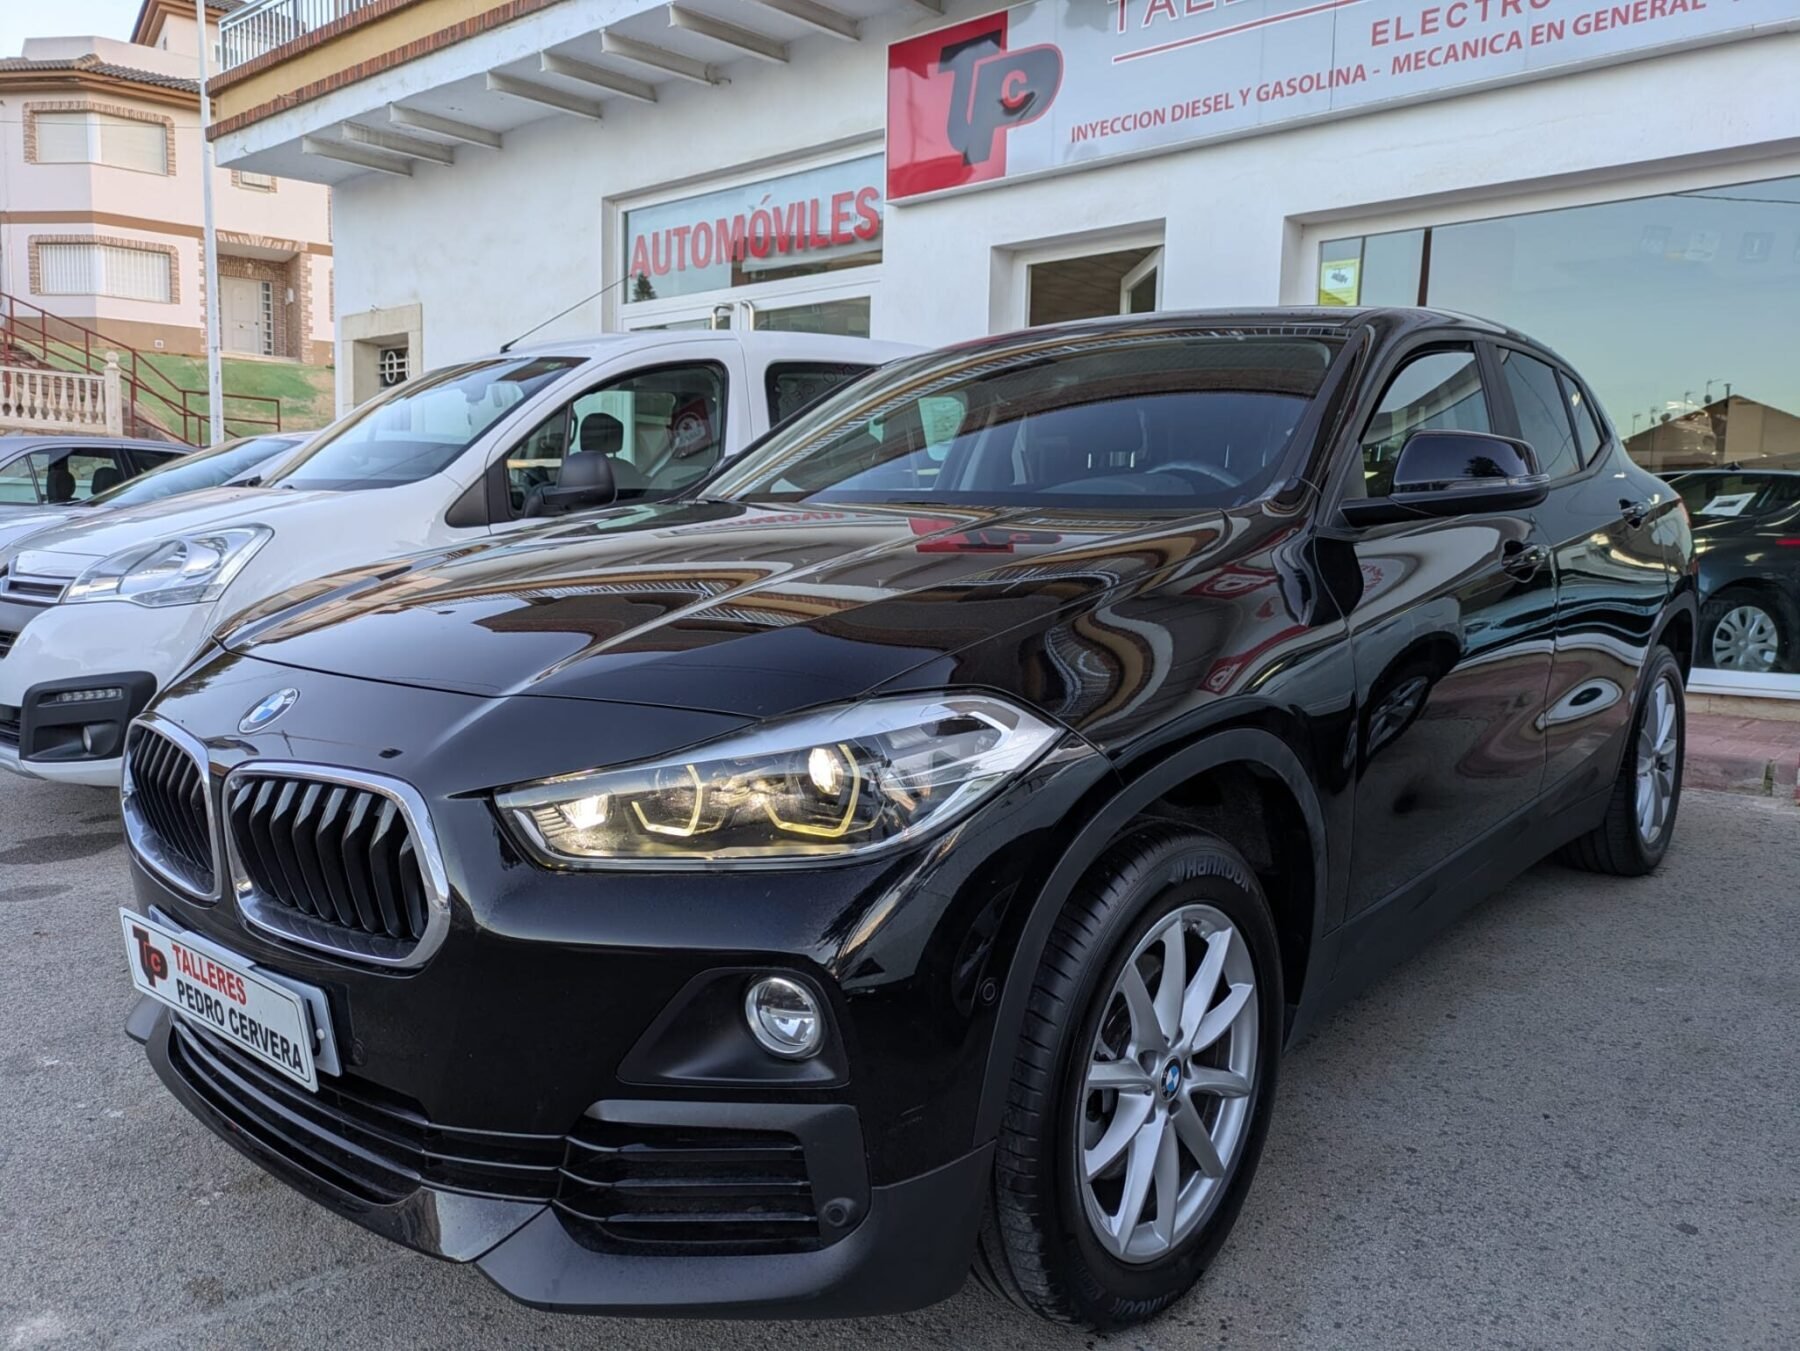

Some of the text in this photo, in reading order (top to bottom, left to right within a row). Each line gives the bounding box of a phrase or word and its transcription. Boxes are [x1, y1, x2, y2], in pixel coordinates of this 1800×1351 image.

[1071, 107, 1166, 143] INYECCION
[1170, 92, 1235, 123] DIESEL
[1239, 88, 1252, 106] Y
[1255, 63, 1367, 103] GASOLINA
[1391, 30, 1523, 75] MECANICA
[1530, 19, 1565, 47] EN
[630, 186, 881, 279] AUTOMÓVILES
[171, 943, 247, 1006] TALLERES
[176, 978, 305, 1074] PEDRO CERVERA
